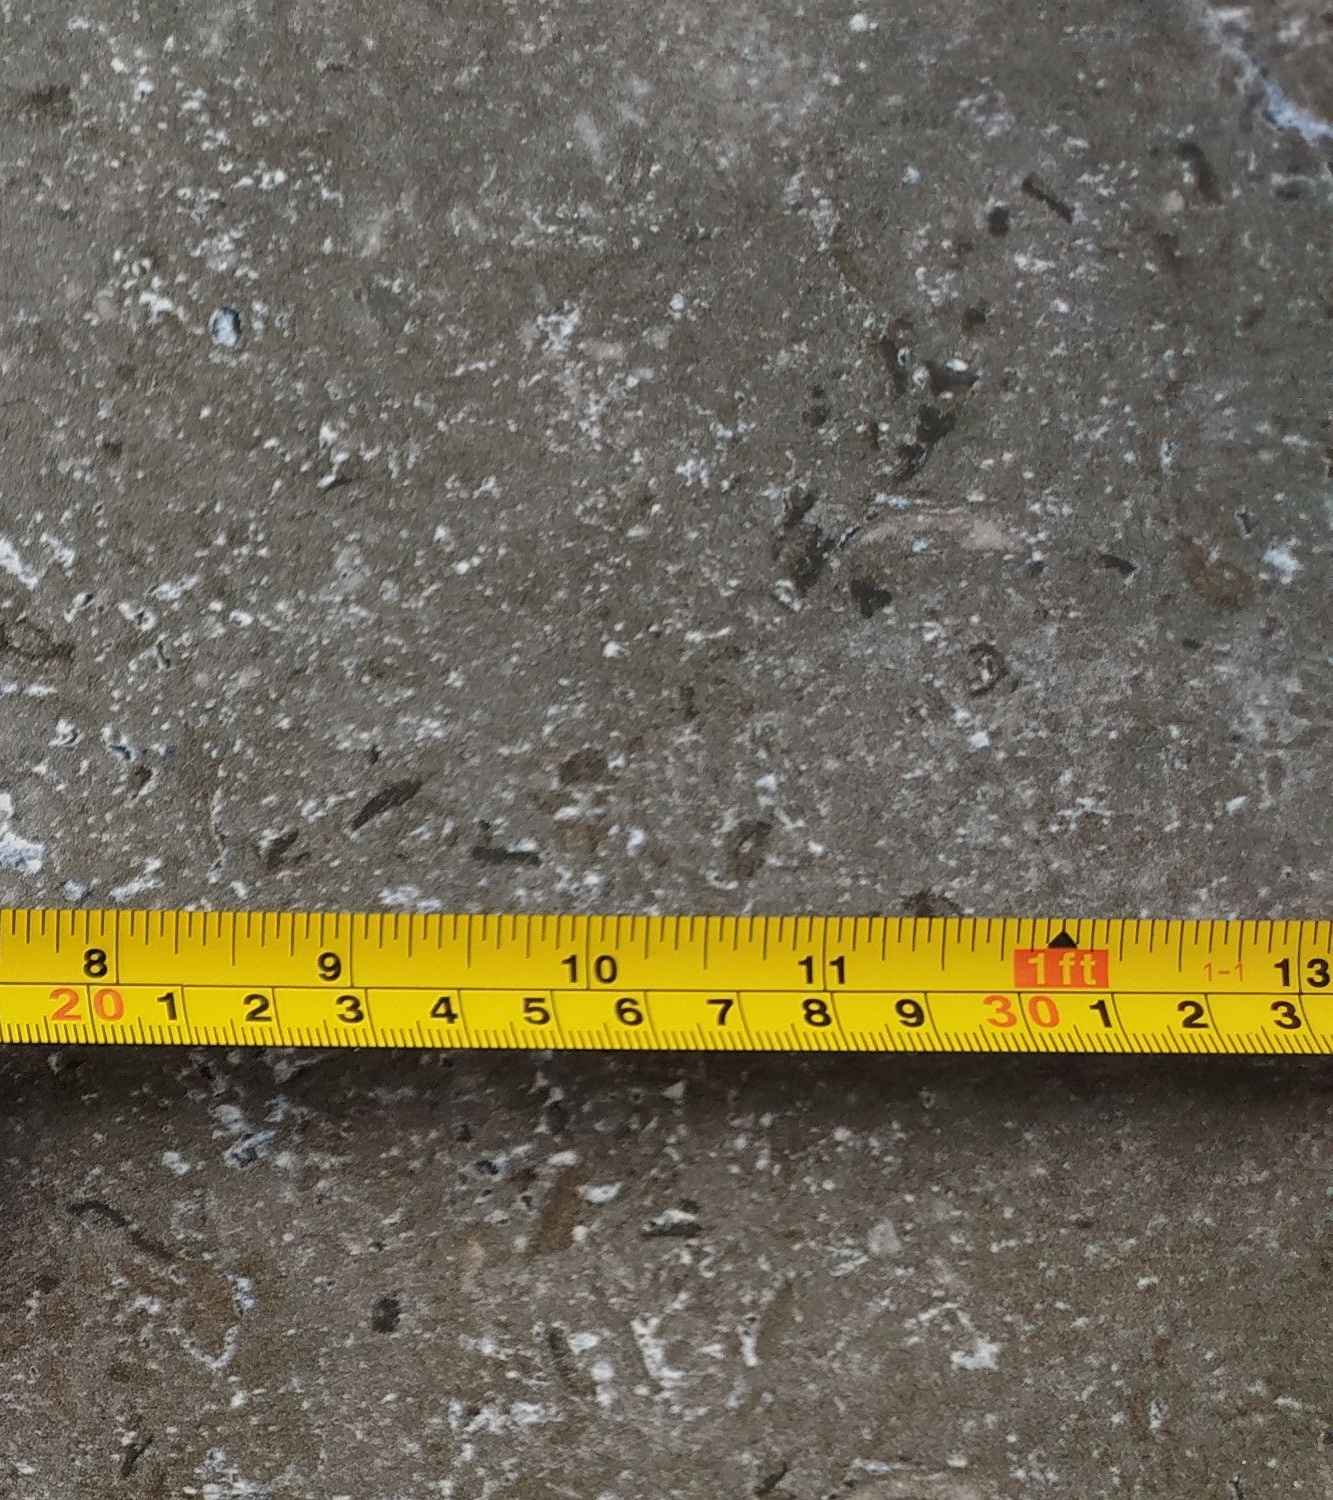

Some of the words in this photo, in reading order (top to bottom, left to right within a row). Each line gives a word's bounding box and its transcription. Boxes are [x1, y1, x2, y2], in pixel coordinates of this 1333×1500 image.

[82, 948, 109, 978] 8
[317, 951, 343, 982] 9
[561, 954, 618, 984] 10
[798, 956, 846, 985] 11
[1028, 954, 1098, 987] 1ft
[1274, 958, 1330, 988] 13
[49, 988, 125, 1023] 20
[157, 993, 179, 1021] 1
[242, 994, 272, 1022] 2
[336, 995, 365, 1023] 3
[430, 996, 458, 1024] 4
[522, 996, 551, 1024] 5
[614, 997, 644, 1025] 6
[706, 999, 735, 1026] 7
[803, 998, 832, 1027] 8
[895, 999, 925, 1027] 9
[982, 995, 1059, 1029] 30
[1089, 1000, 1112, 1027] 1
[1179, 1000, 1209, 1029] 2
[1272, 1000, 1301, 1029] 3
